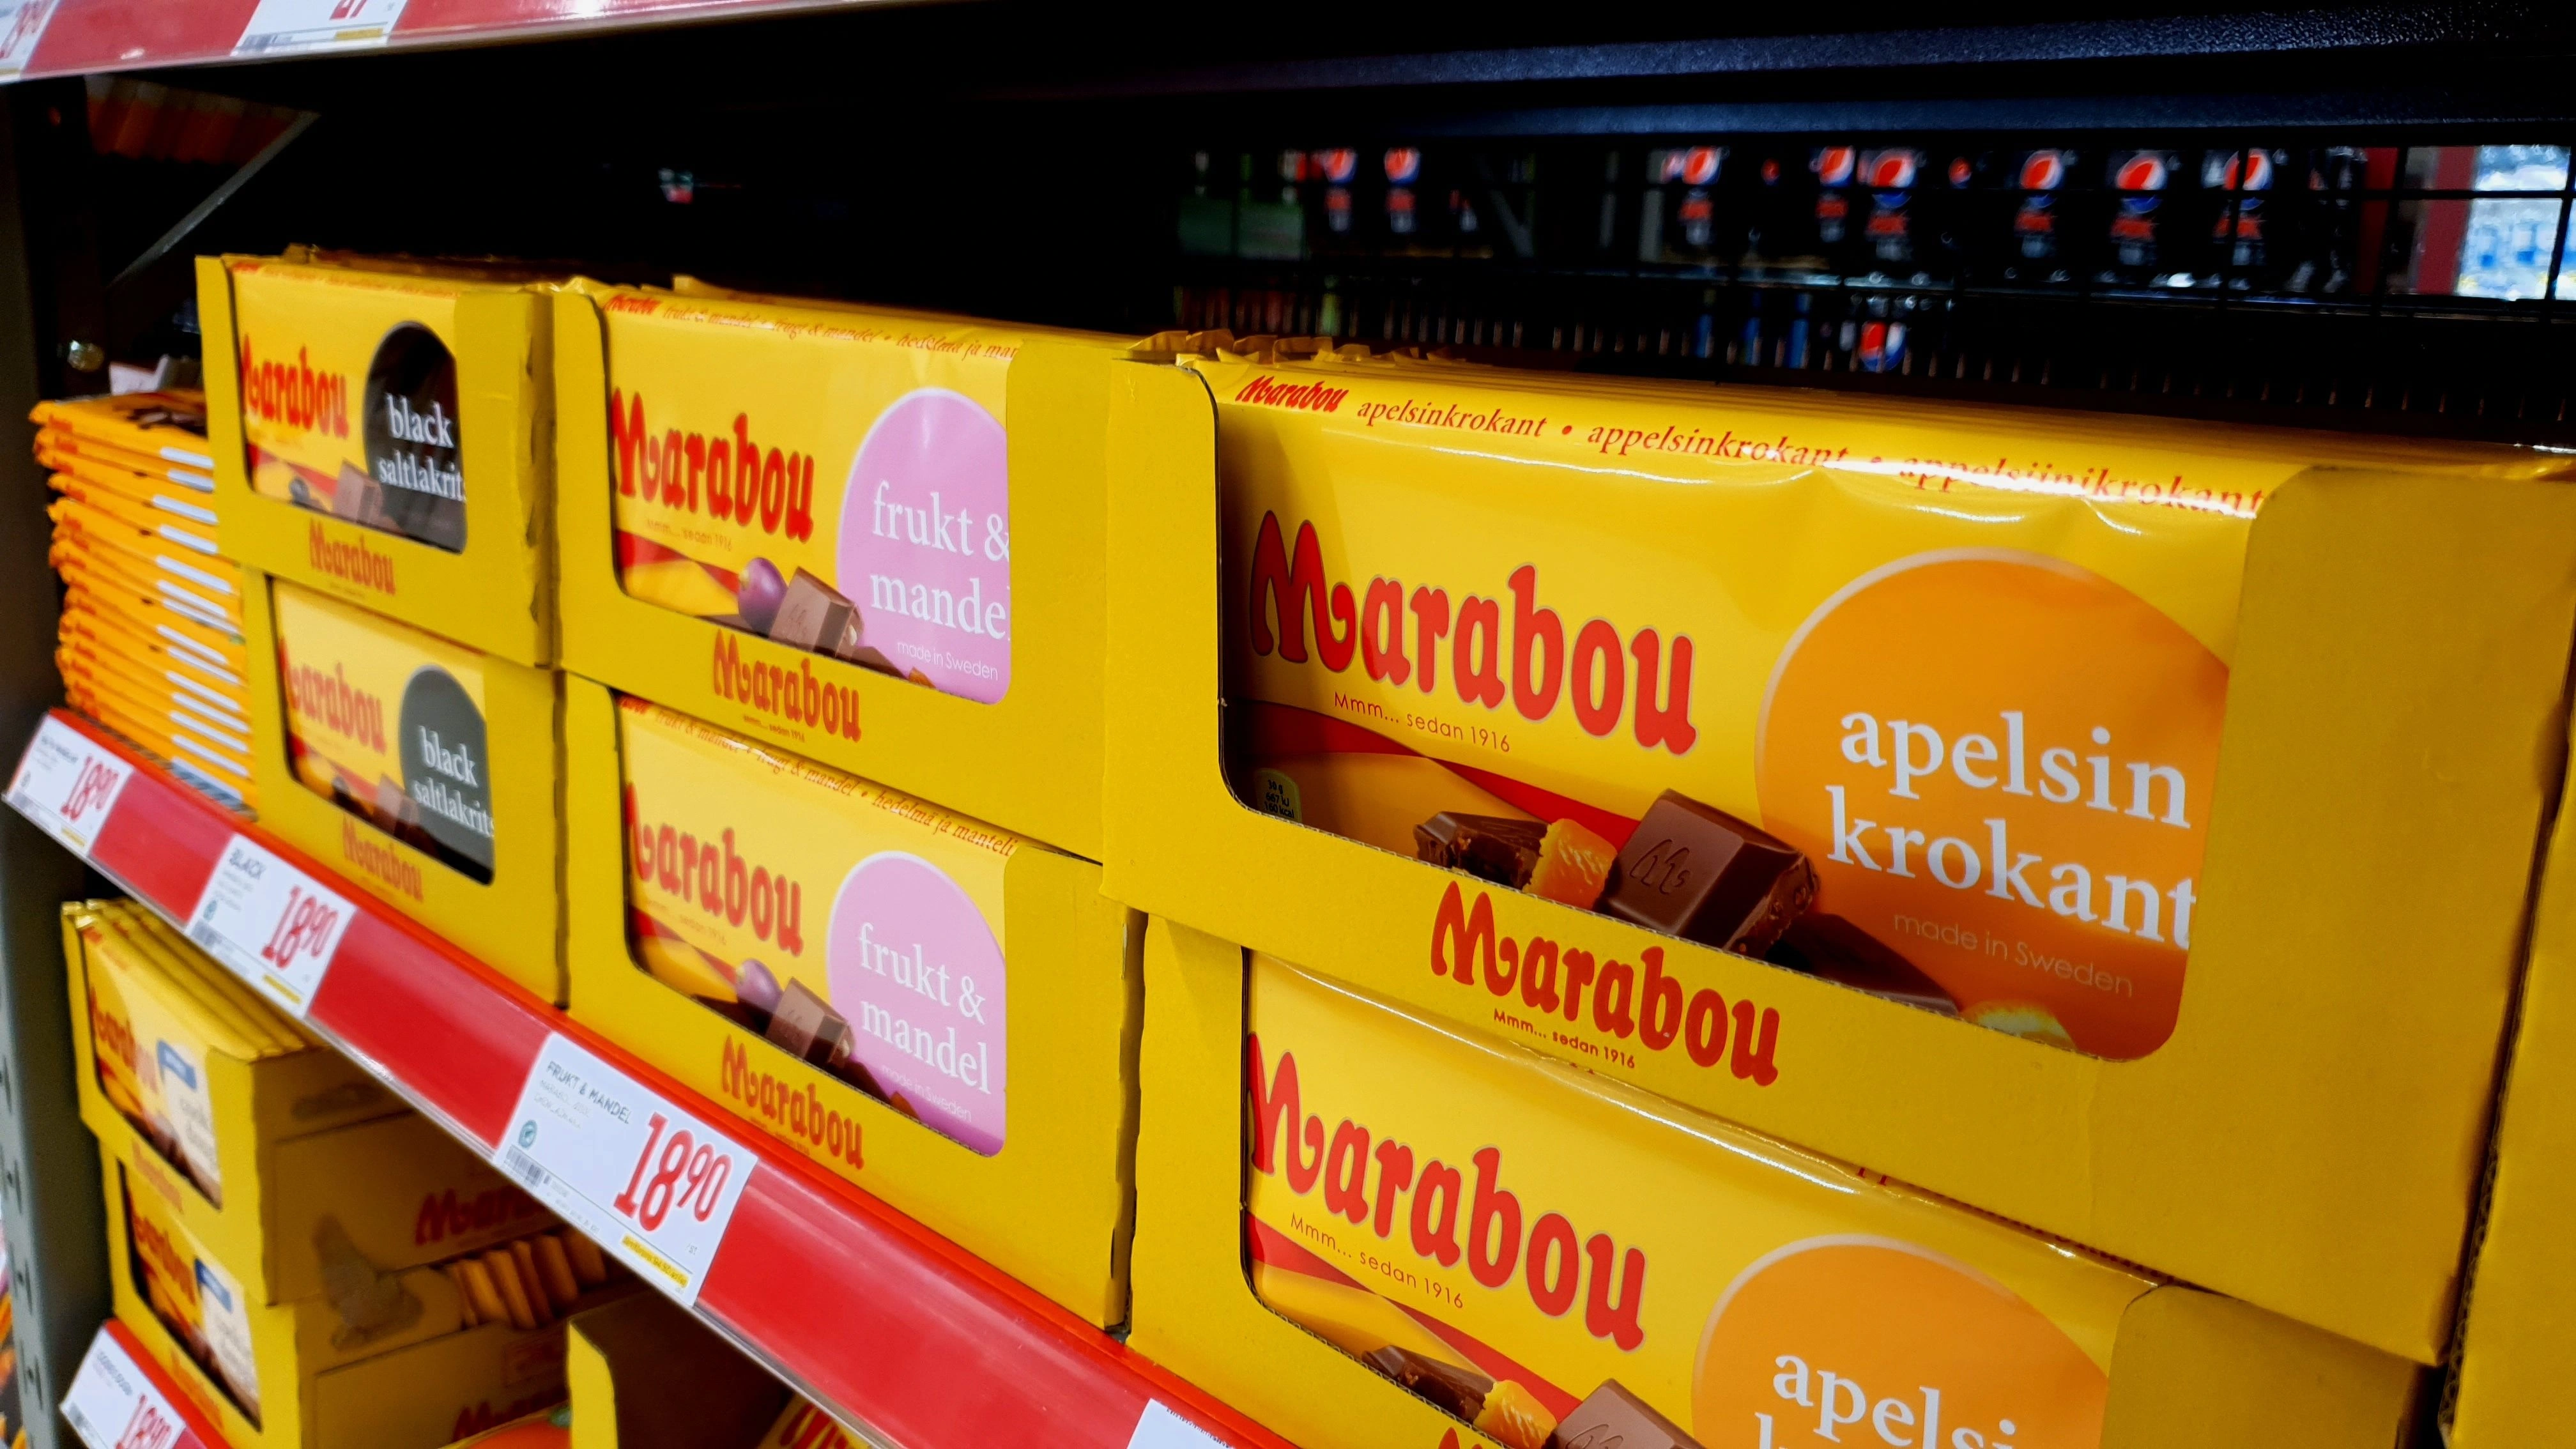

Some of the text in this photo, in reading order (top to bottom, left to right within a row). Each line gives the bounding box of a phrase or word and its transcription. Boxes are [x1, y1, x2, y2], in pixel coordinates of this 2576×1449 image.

[385, 392, 455, 448] black
[610, 387, 815, 543] Marabou
[1235, 375, 1349, 413] Marabou
[1357, 399, 1547, 438] apelsinkrokant
[1587, 421, 1850, 468] appelsinkrokant
[309, 518, 396, 596] Marabou
[872, 481, 1010, 563] frukt &
[870, 572, 1010, 641] mande
[1249, 509, 1699, 756] Marabou
[712, 628, 862, 743] Marabou
[897, 641, 999, 680] made in Sweden
[418, 725, 479, 788] black
[1333, 691, 1511, 753] Mmm... sedan 1916
[804, 767, 861, 797] mandel
[871, 789, 937, 827] hedelmä
[934, 815, 954, 835] ja
[952, 824, 1018, 857] manteli
[1841, 710, 2191, 829] apelsin
[1825, 785, 2197, 951] krokant
[859, 921, 986, 1027] frukt &
[1430, 880, 1782, 1087] Marabou
[1894, 912, 2134, 999] made in Sweden
[859, 998, 992, 1096] mandel
[1493, 1008, 1636, 1070] Mmm... sedan 1916
[546, 1060, 581, 1089] FRUKT
[588, 1087, 633, 1124] MANDEL
[721, 1034, 866, 1171] Marabou
[926, 1086, 972, 1123] Sweden
[1247, 1032, 1646, 1353] Marabou
[1291, 1211, 1464, 1311] Mmm... sedan 1916
